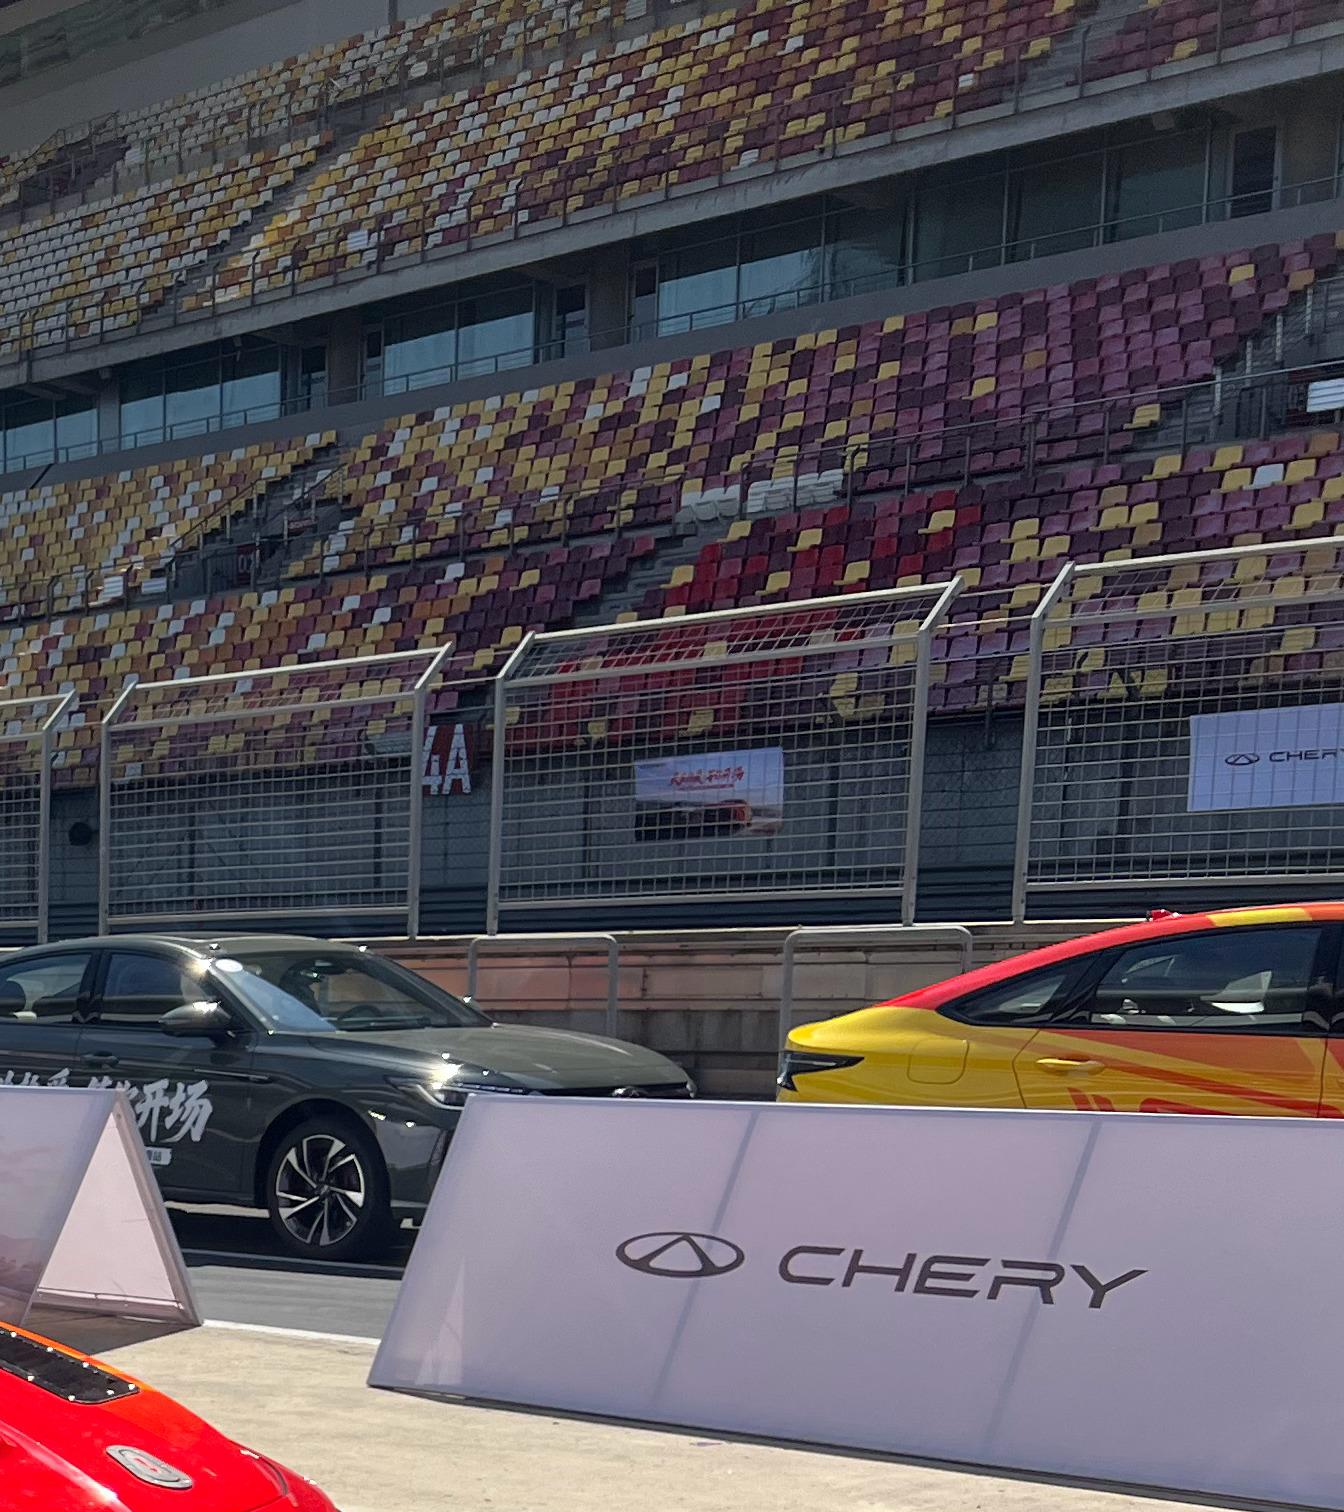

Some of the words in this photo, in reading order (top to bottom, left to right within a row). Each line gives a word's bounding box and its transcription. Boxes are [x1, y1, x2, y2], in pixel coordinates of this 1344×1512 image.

[421, 723, 472, 795] 4A
[1269, 748, 1344, 763] CHER
[778, 1245, 1149, 1308] CHERY
